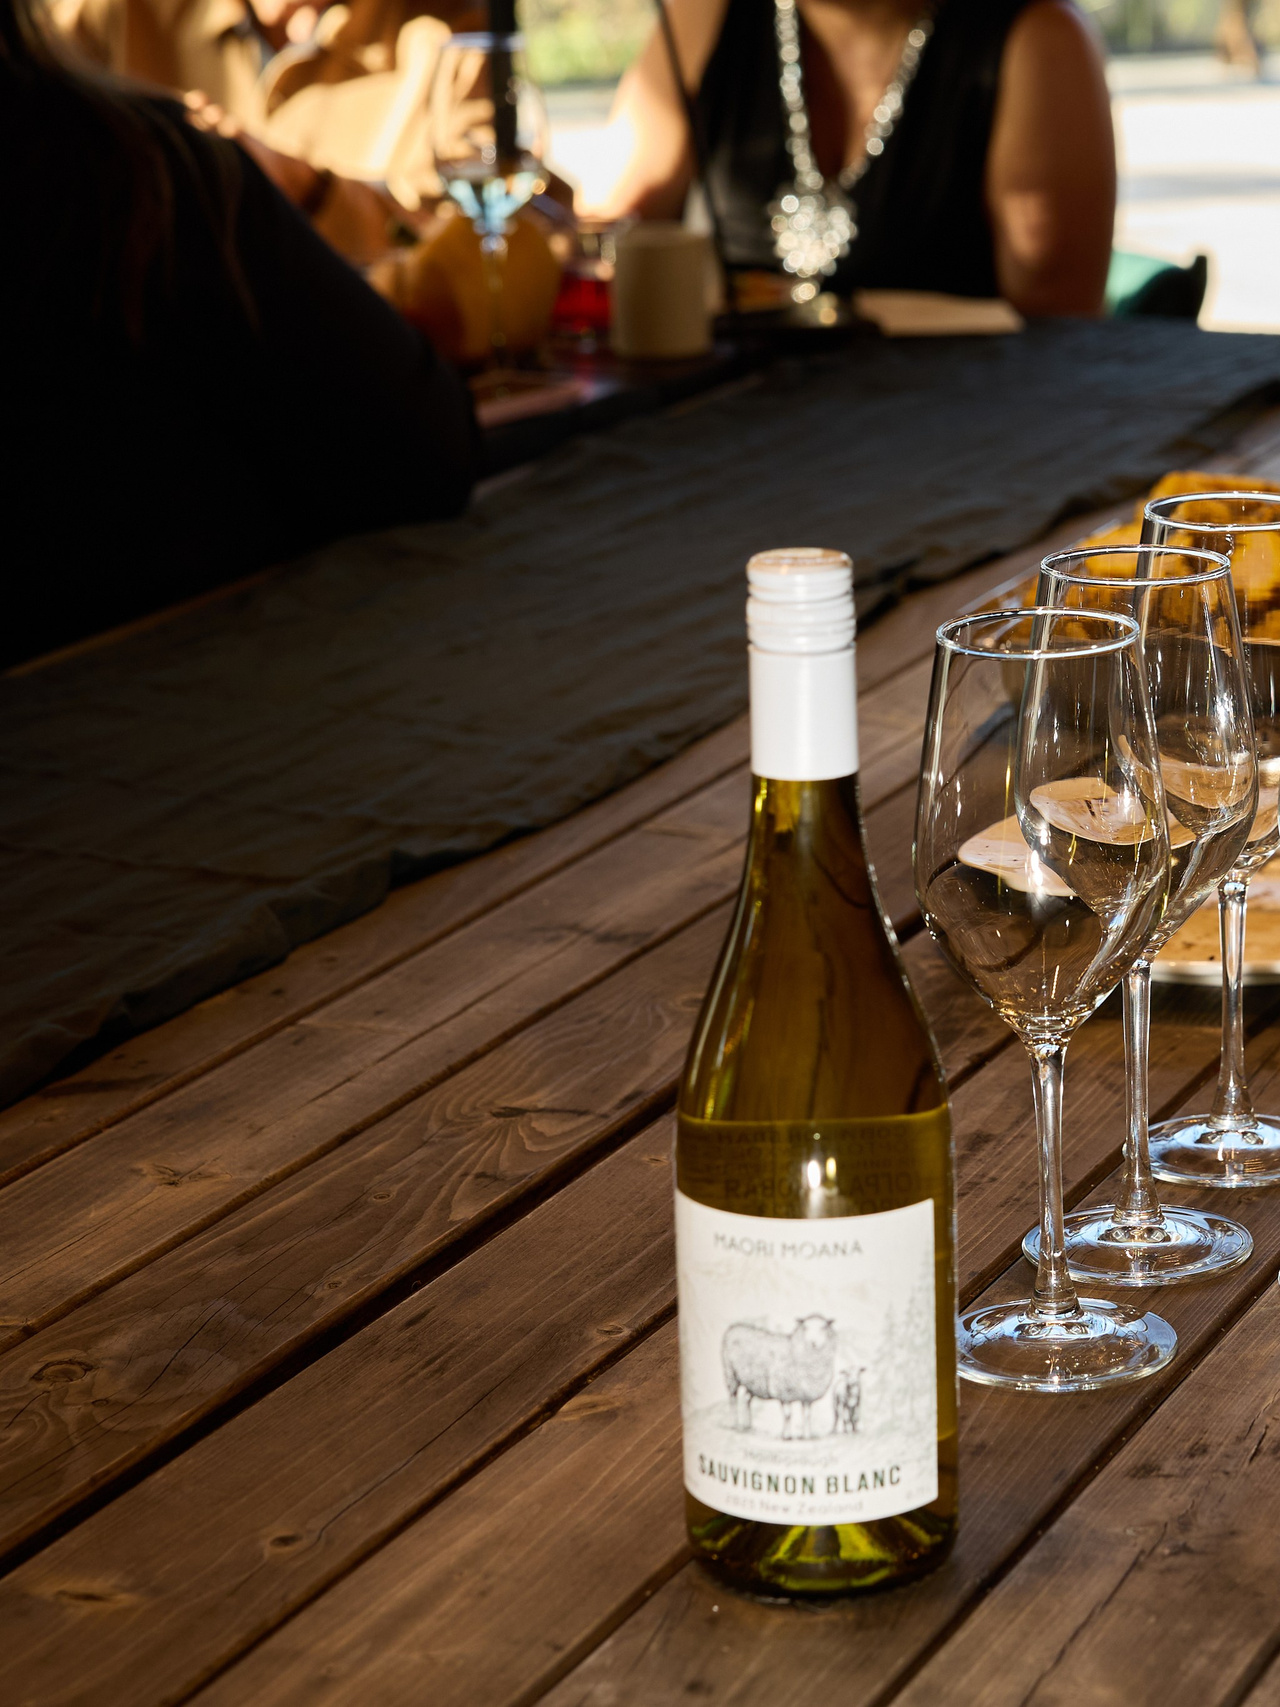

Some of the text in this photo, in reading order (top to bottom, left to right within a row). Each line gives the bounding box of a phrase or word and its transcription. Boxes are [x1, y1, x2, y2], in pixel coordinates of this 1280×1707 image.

[713, 1231, 864, 1259] MAORI MOANA
[697, 1453, 815, 1495] SAUVIGNON
[825, 1465, 902, 1494] BLANC
